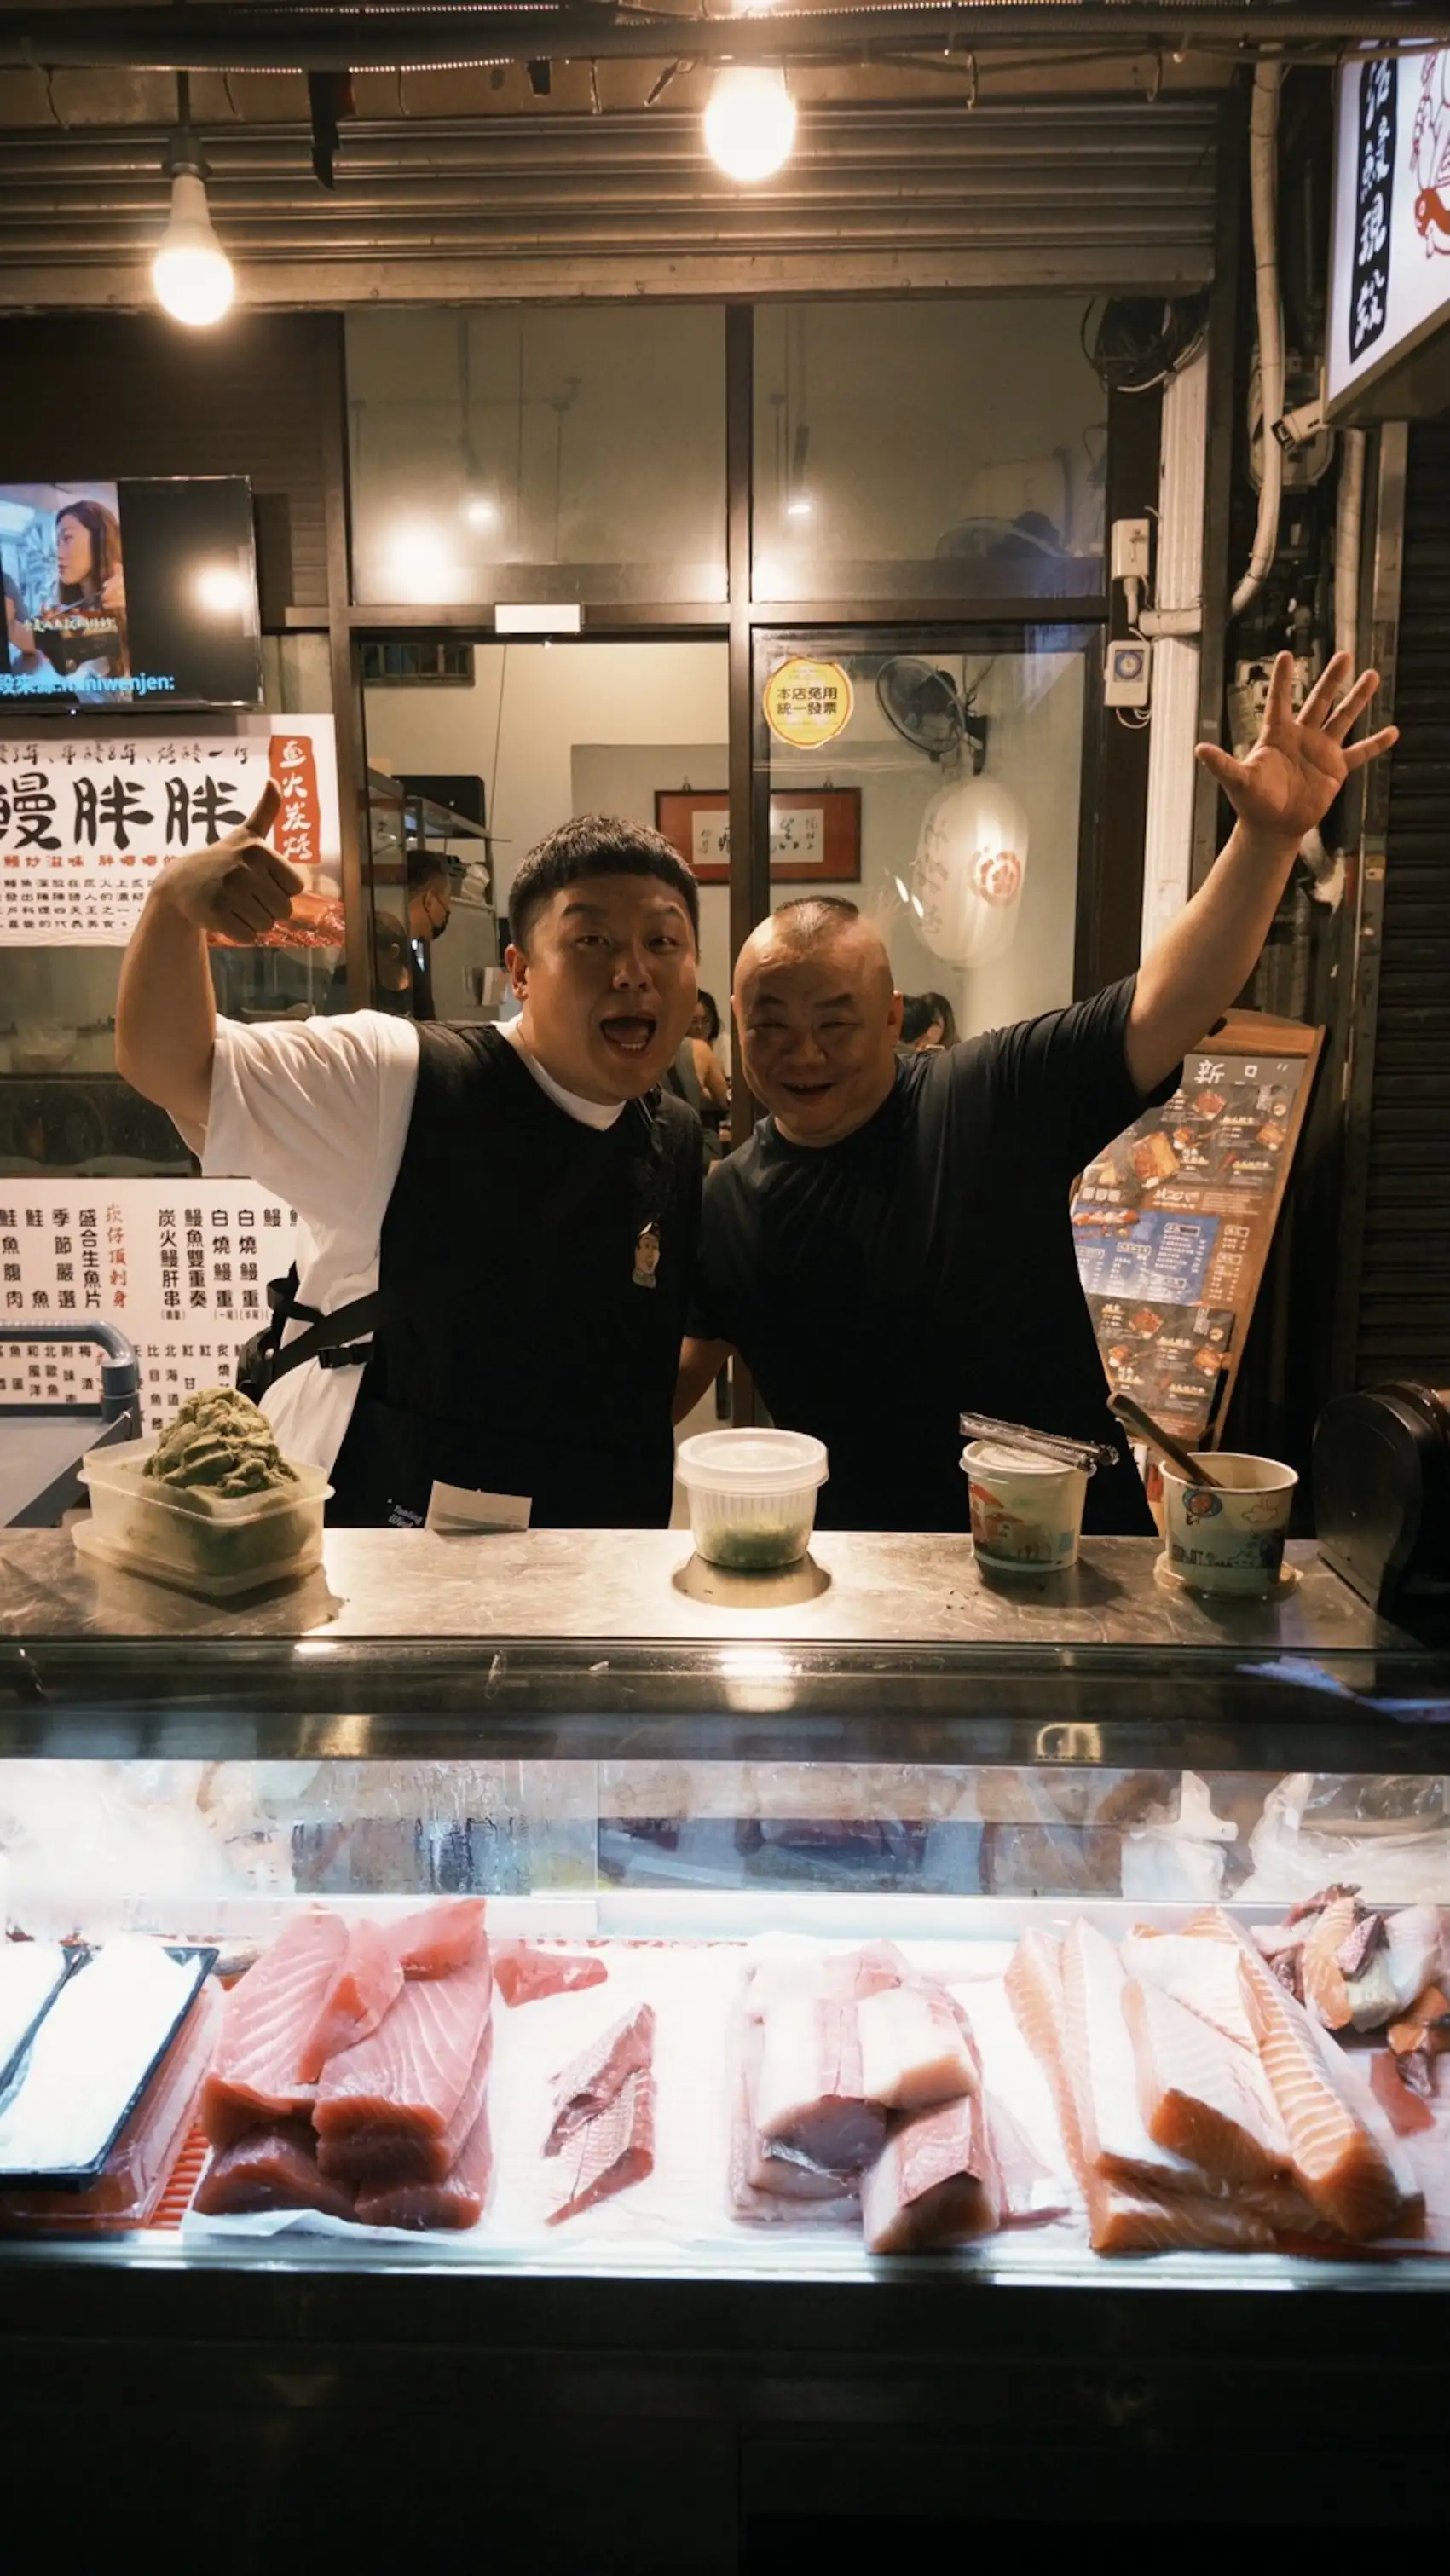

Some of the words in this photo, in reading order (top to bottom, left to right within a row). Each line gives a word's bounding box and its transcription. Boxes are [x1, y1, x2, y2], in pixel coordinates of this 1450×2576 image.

[777, 687, 838, 700] 本店免用
[777, 702, 837, 715] 統一發票
[0, 1208, 24, 1308] 鮭魚腹肉
[26, 1208, 50, 1308] 鮭魚
[52, 1208, 77, 1308] 季節嚴選
[78, 1208, 102, 1308] 盛合生魚片
[106, 1203, 127, 1308] 崁仔頂刺身
[159, 1209, 180, 1308] 炭火鰻肝串
[184, 1209, 208, 1308] 鰻魚雙重奏
[211, 1209, 234, 1308] 白燒鰻重
[238, 1209, 259, 1308] 白燒鰻重
[165, 1343, 179, 1421] 北海道
[217, 1343, 230, 1388] 炙燒
